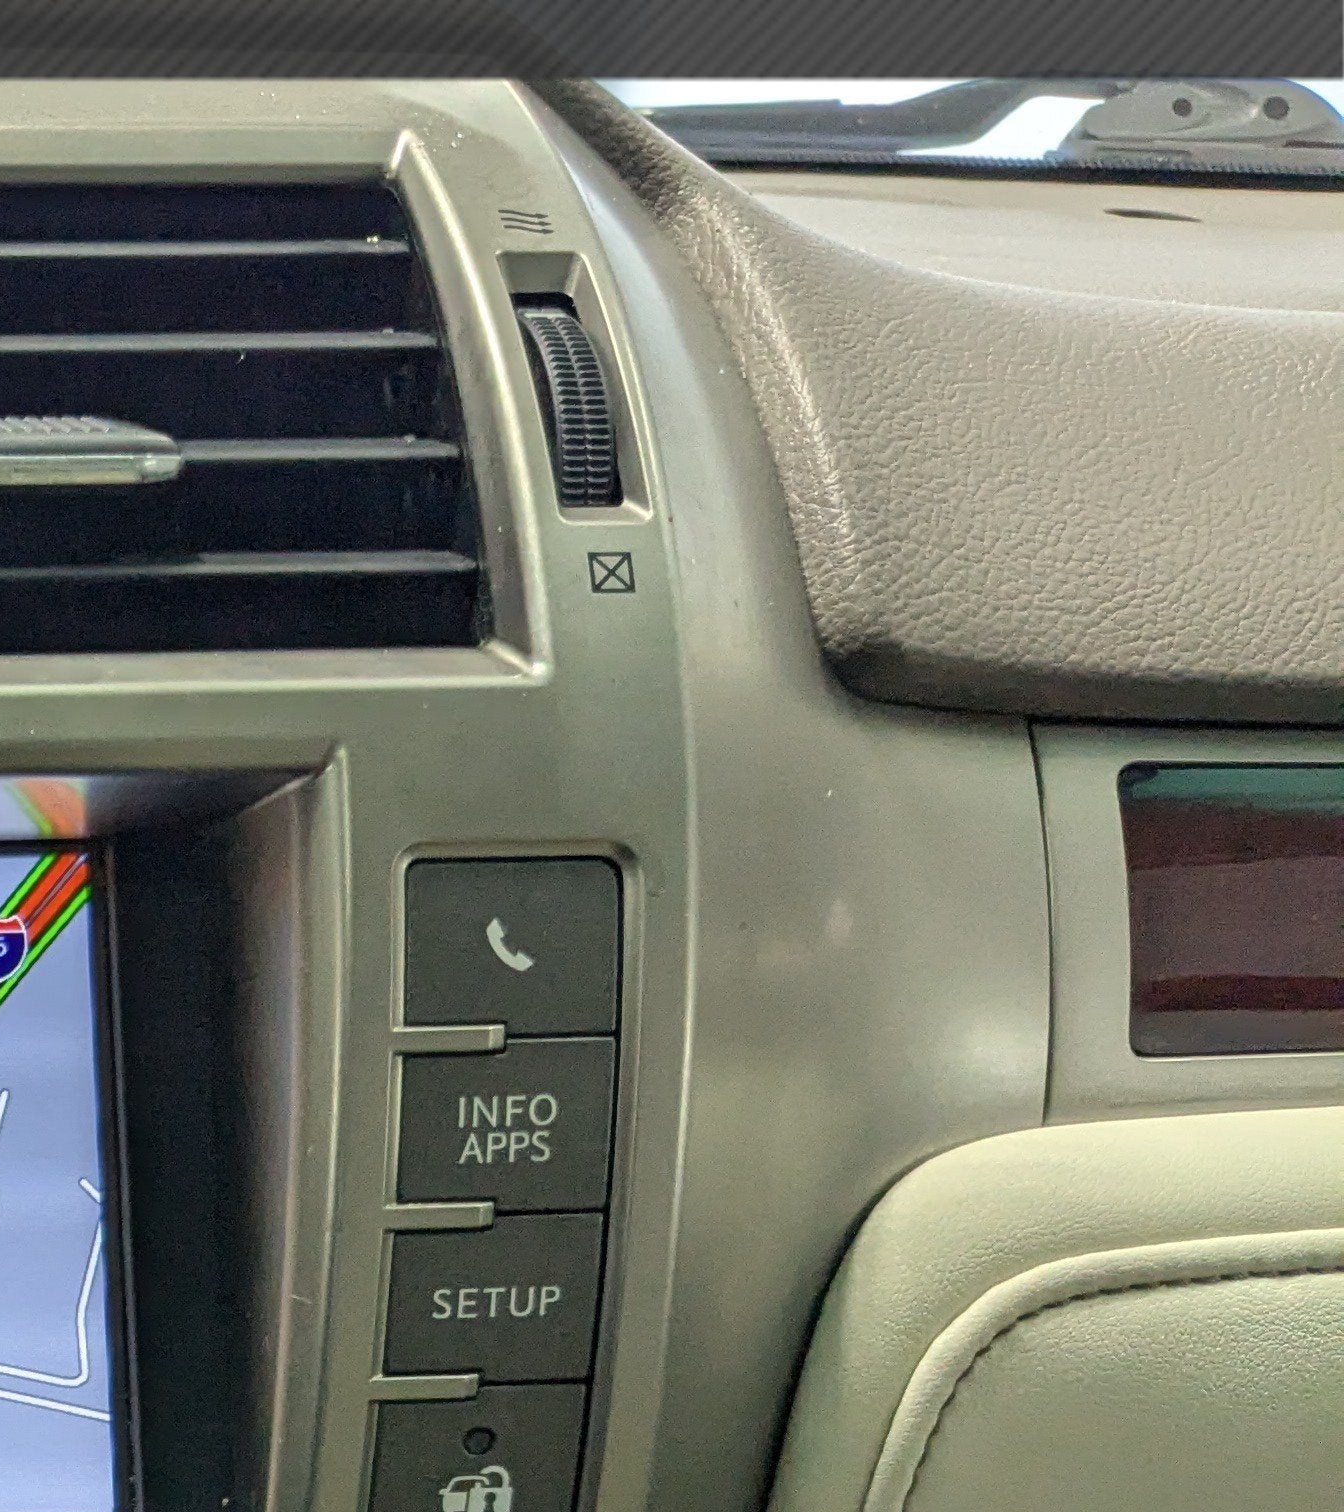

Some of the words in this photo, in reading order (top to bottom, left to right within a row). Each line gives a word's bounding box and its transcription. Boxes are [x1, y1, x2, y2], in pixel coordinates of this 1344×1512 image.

[457, 1093, 558, 1129] INFO
[457, 1130, 553, 1165] APPS
[431, 1285, 562, 1319] SETUP
